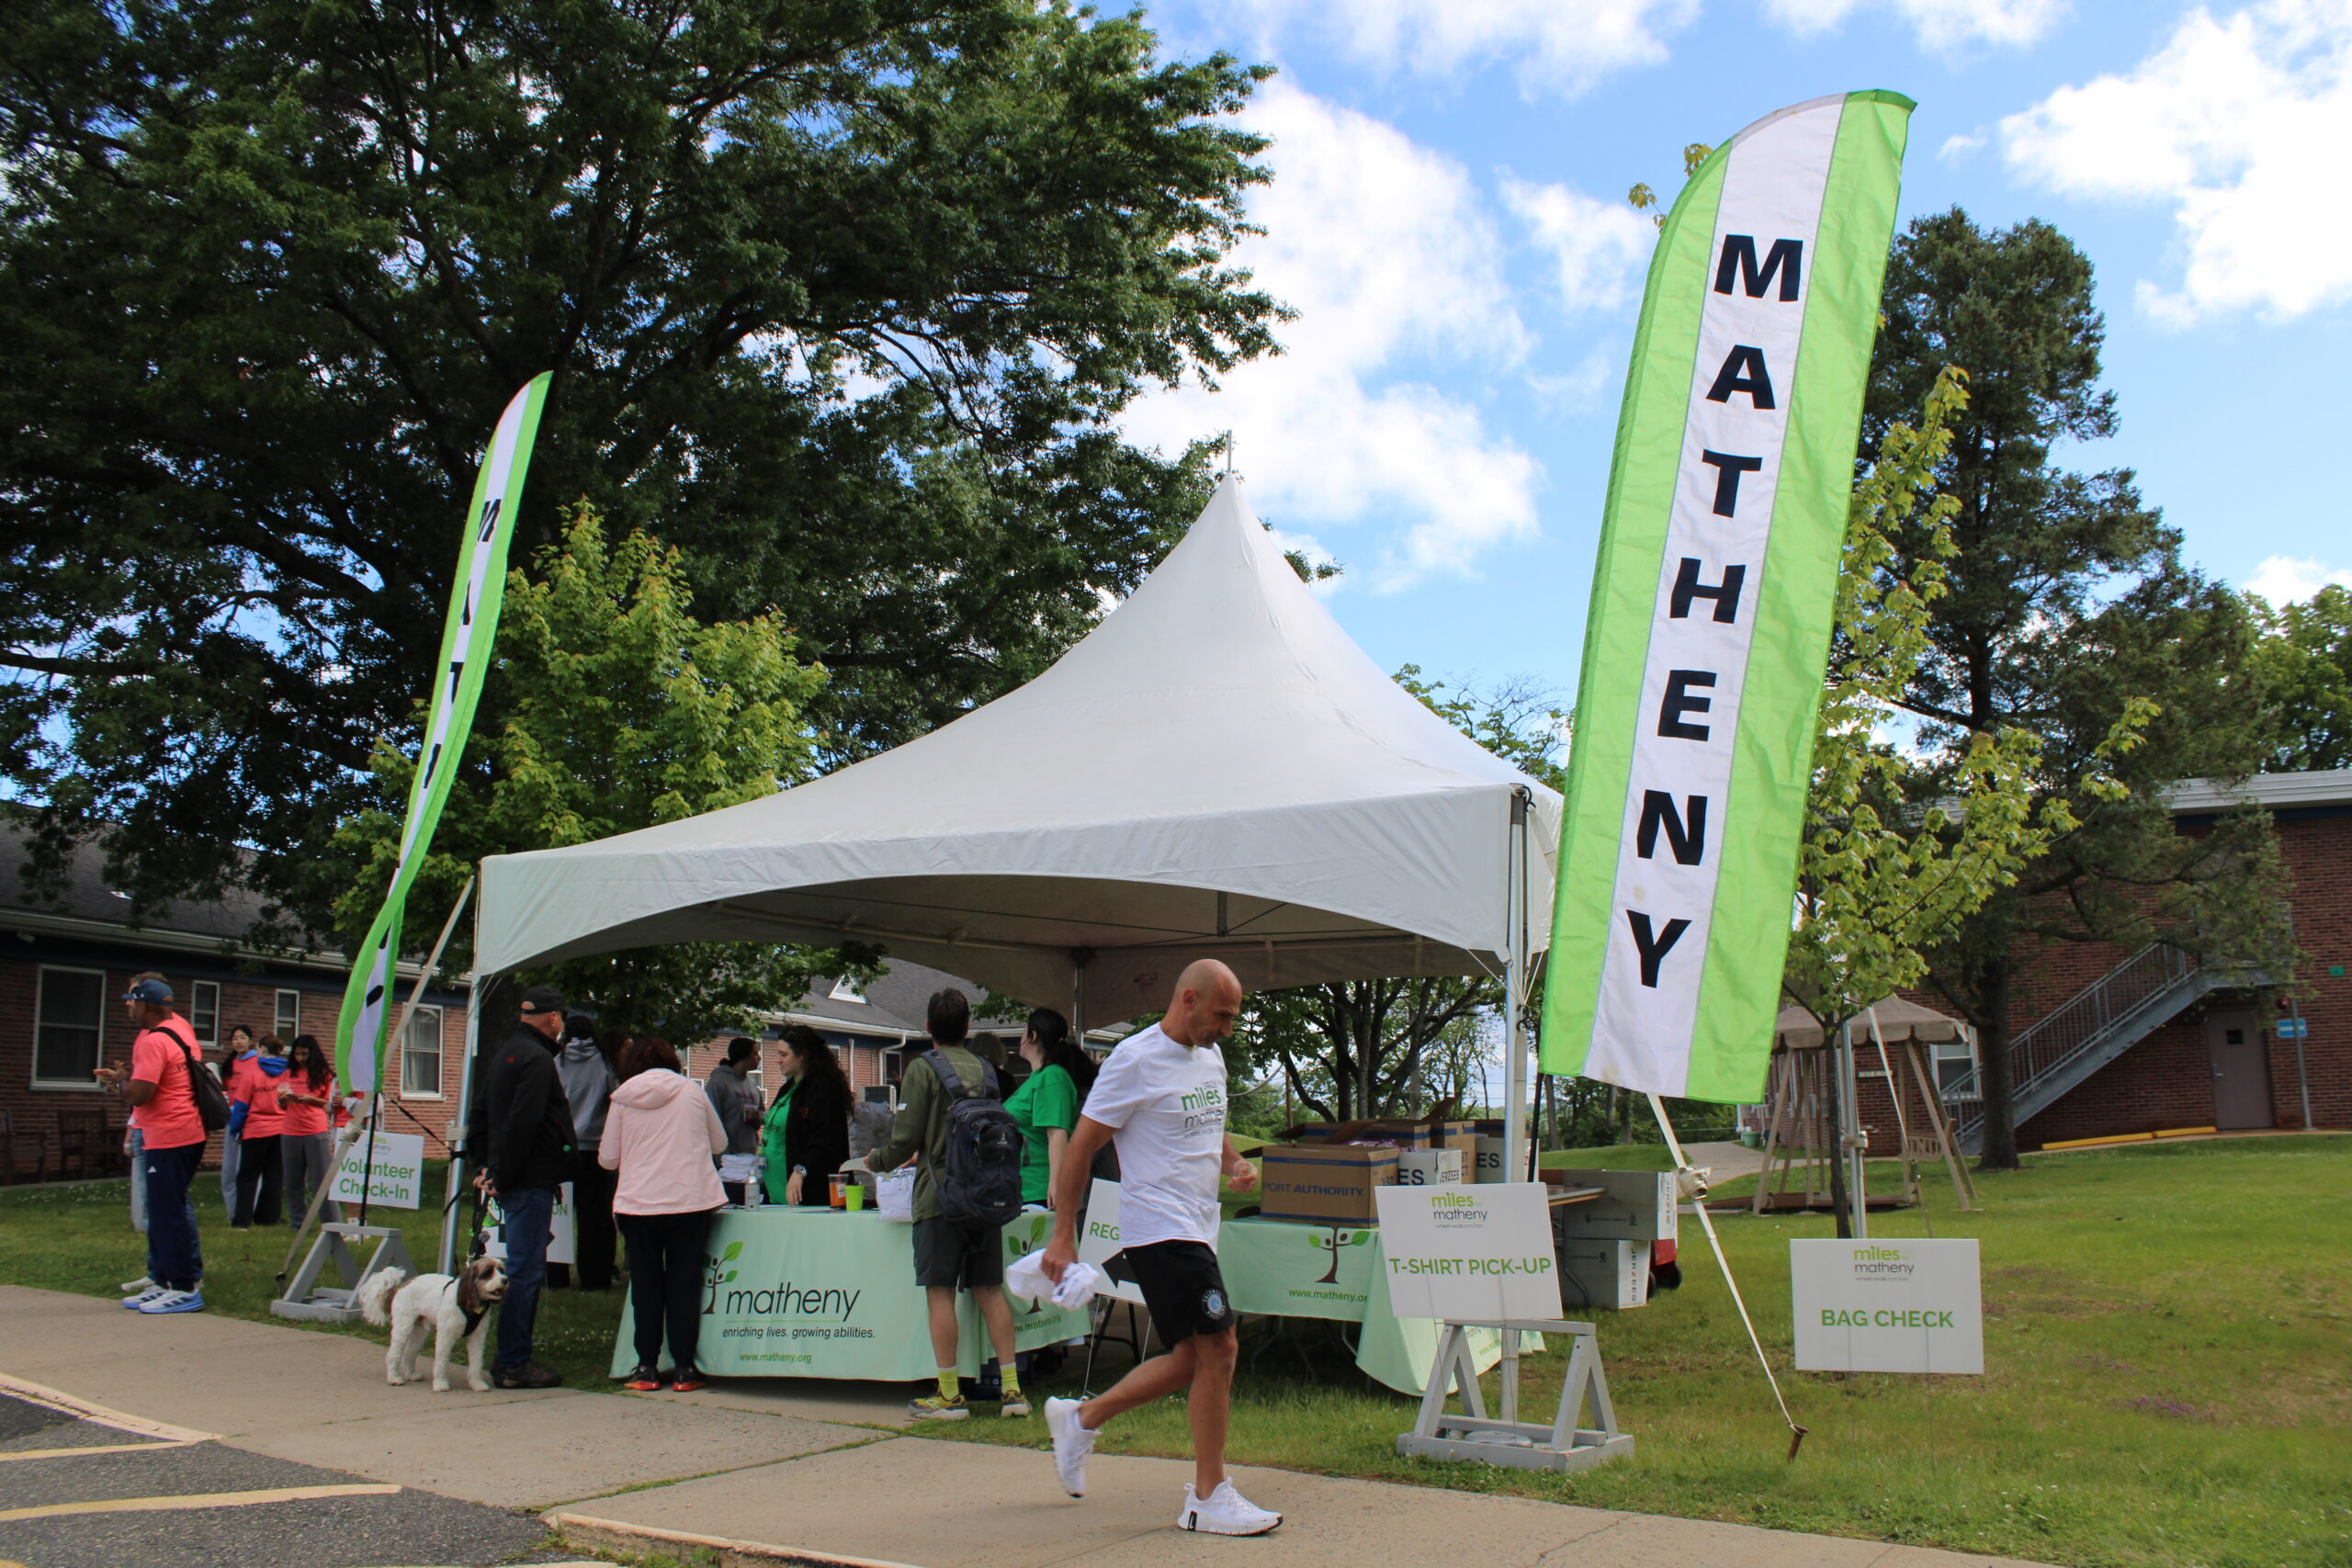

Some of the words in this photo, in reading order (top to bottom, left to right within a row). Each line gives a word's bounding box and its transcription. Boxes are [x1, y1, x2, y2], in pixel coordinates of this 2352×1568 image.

[1625, 233, 1804, 989] MATHENY
[1181, 1087, 1221, 1111] miles
[1262, 1182, 1292, 1192] PORT
[1294, 1183, 1364, 1197] AUTHORITY
[1431, 1192, 1474, 1208] miles
[1433, 1208, 1487, 1222] matheny
[1853, 1246, 1901, 1260] miles
[1389, 1258, 1464, 1274] T-SHIRT
[1468, 1258, 1552, 1275] PICK-UP
[1854, 1261, 1915, 1275] matheny
[726, 1281, 861, 1322] matheny
[1821, 1309, 1869, 1326] BAG
[1874, 1310, 1954, 1328] CHECK
[722, 1326, 763, 1338] enriching
[766, 1326, 788, 1337] lives.
[792, 1326, 831, 1340] growing
[833, 1326, 876, 1338] abilities.
[739, 1352, 812, 1364] www.matheny.org
